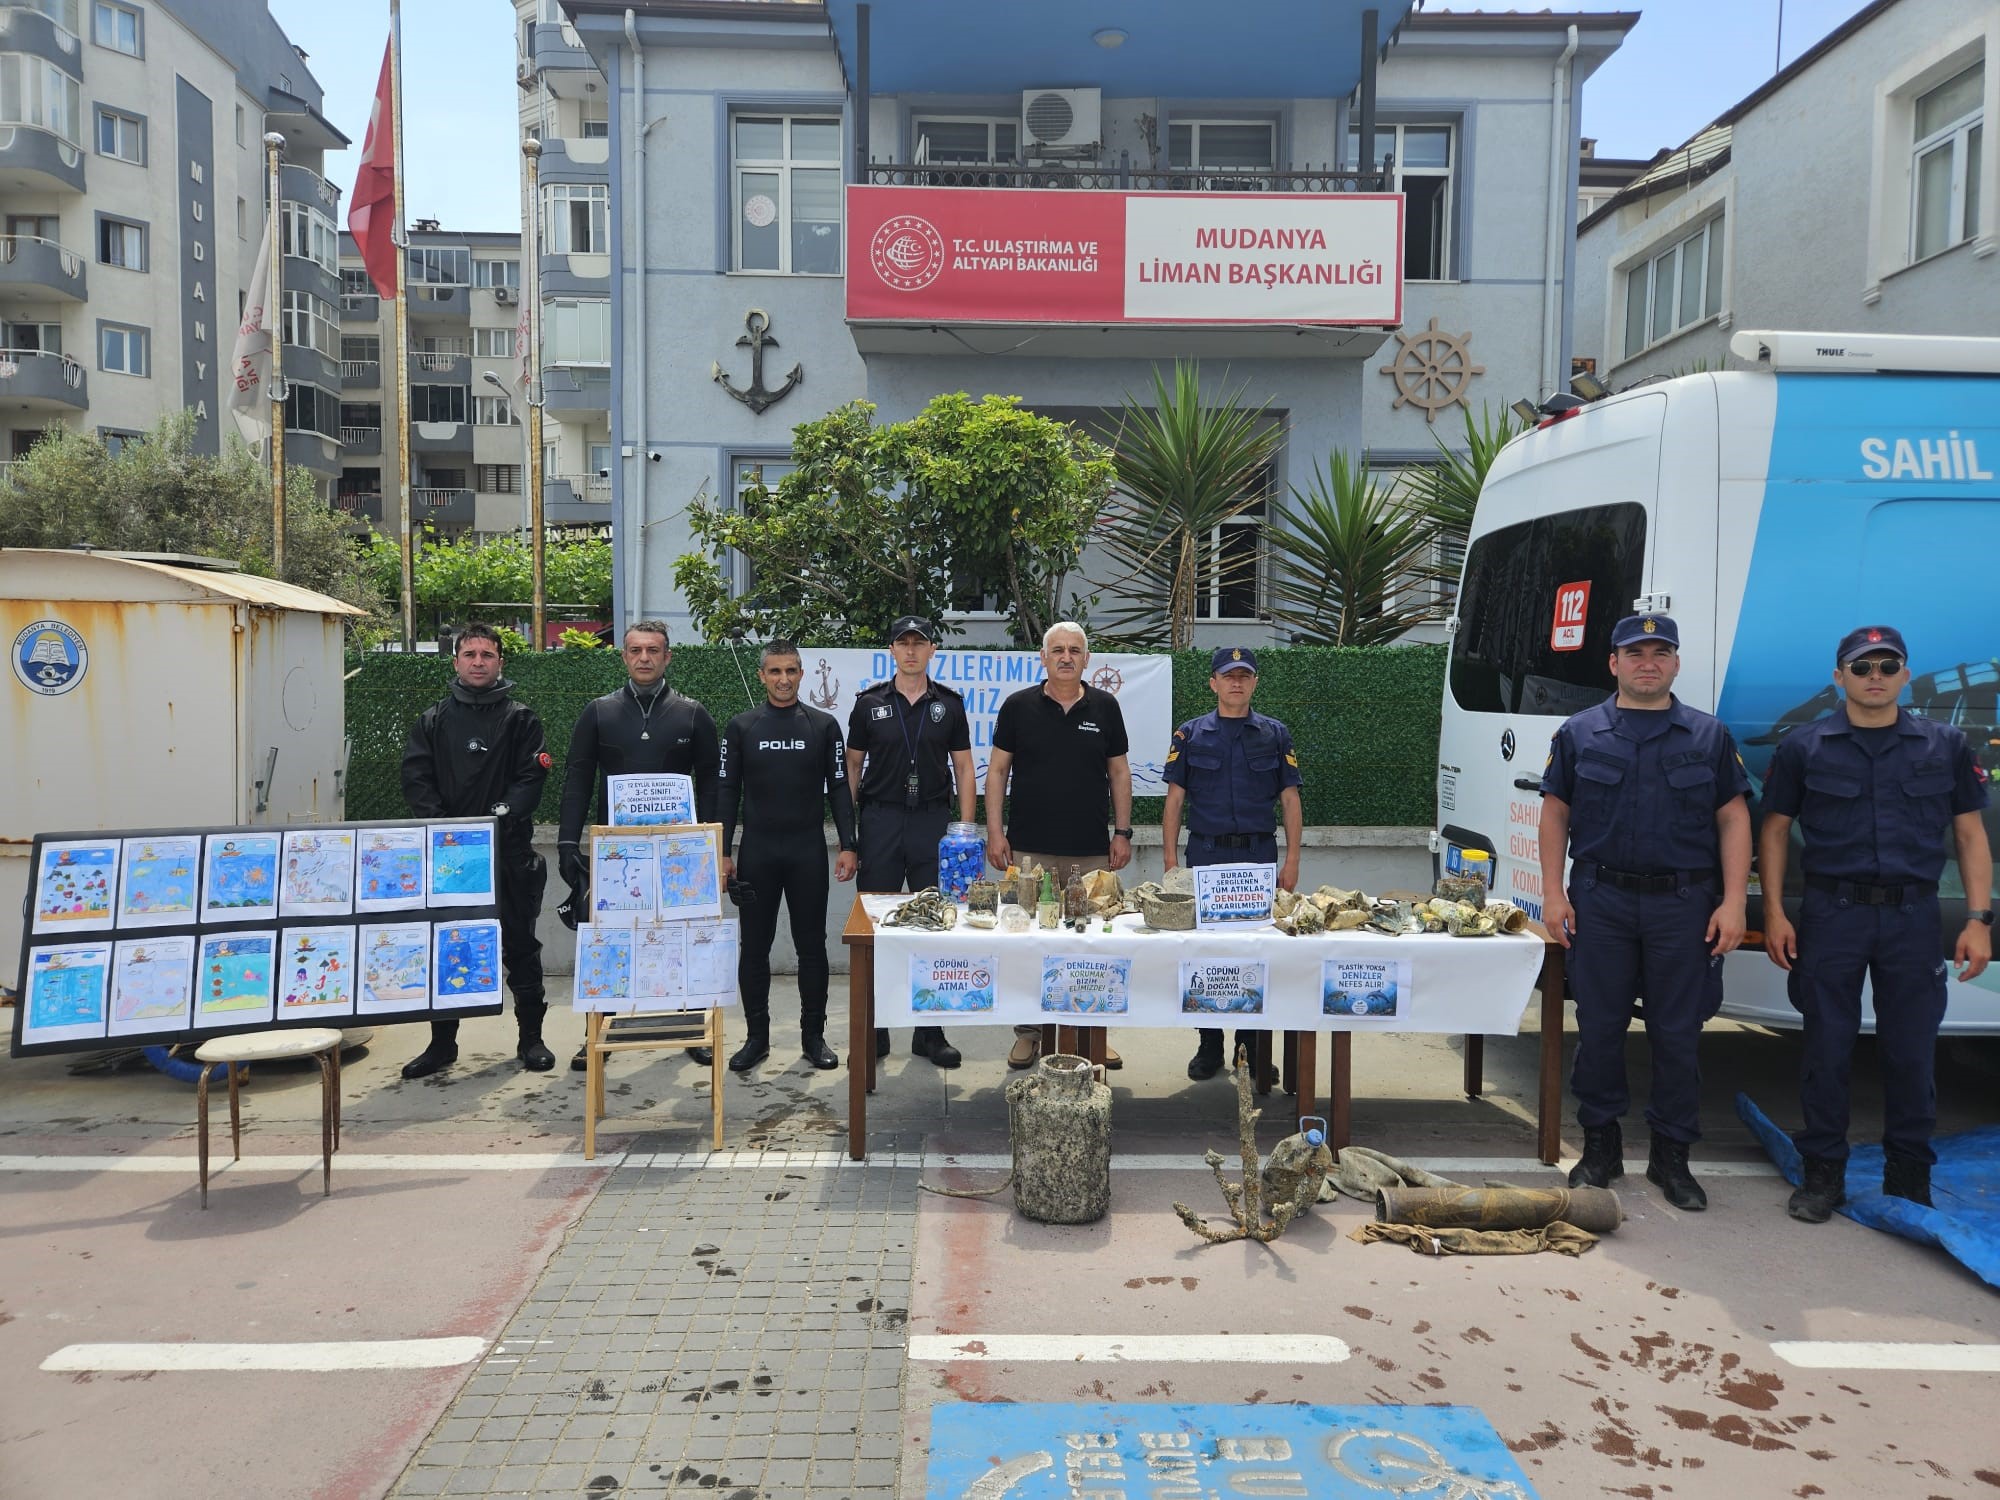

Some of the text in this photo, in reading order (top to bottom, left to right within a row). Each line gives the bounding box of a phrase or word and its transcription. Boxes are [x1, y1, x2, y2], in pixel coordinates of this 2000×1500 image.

[1195, 228, 1328, 250] MUDANYA
[952, 239, 1099, 257] T.C. ULAŞTIRMA VE
[952, 256, 1099, 272] ALTYAPI BAKANLIĞI
[1138, 257, 1383, 290] LİMAN BAŞKANLIĞI
[190, 160, 208, 420] MUDANYA
[1815, 347, 1847, 357] THULE
[1860, 430, 1994, 480] SAHİL
[564, 526, 613, 541] EMLA
[1560, 589, 1585, 622] 112
[16, 623, 46, 646] MUDANYA
[759, 738, 806, 750] POLİS
[635, 788, 671, 796] 3-C SINIFI
[630, 801, 677, 814] DENİZLER
[1510, 832, 1541, 862] GÜVE
[1220, 871, 1254, 879] BURADA
[1216, 877, 1259, 886] SERGİLENEN
[1211, 884, 1265, 894] TÜM ATIKLAR
[1214, 892, 1264, 903] DENİZDEN
[1211, 901, 1267, 911] ÇIKARILMIŞTIR
[933, 959, 969, 970] ÇÖPÜNÜ
[1066, 959, 1108, 971] DENİZLERİ
[1338, 962, 1386, 972] PLASTİK YOKSA
[932, 969, 970, 981] DENİZE
[1070, 970, 1106, 979] KORUMAK
[1206, 975, 1230, 983] YANINA
[1342, 971, 1383, 980] DENİZLER
[938, 982, 968, 991] ATMA!
[1207, 982, 1239, 990] DOĞAYA
[1338, 980, 1385, 989] NEFES ALIR!
